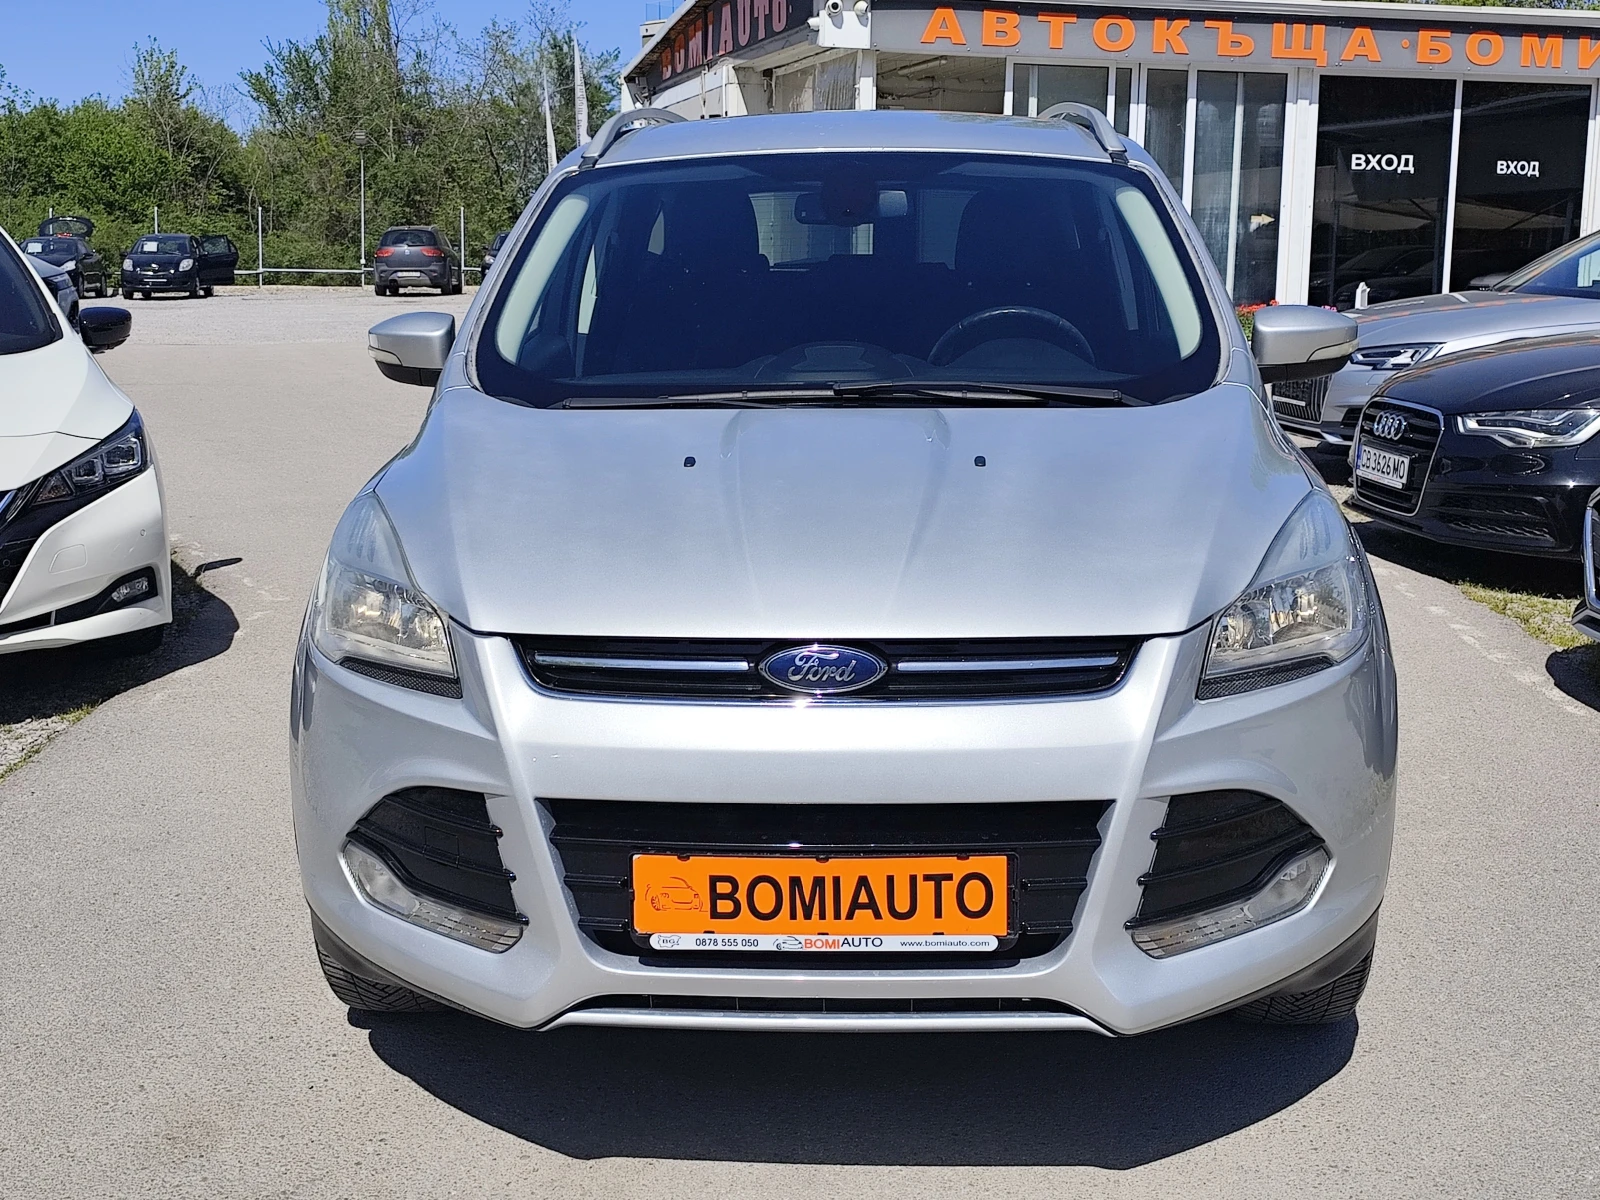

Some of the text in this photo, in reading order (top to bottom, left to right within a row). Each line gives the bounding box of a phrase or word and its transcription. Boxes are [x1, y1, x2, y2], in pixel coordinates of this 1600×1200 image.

[1351, 153, 1415, 174] ВХОД
[1496, 160, 1540, 177] ВХОД
[787, 651, 857, 681] Ford
[708, 872, 994, 921] BOMIAUTO
[695, 938, 759, 948] 0878 555 050
[900, 940, 990, 948] www.bomiauto.com
